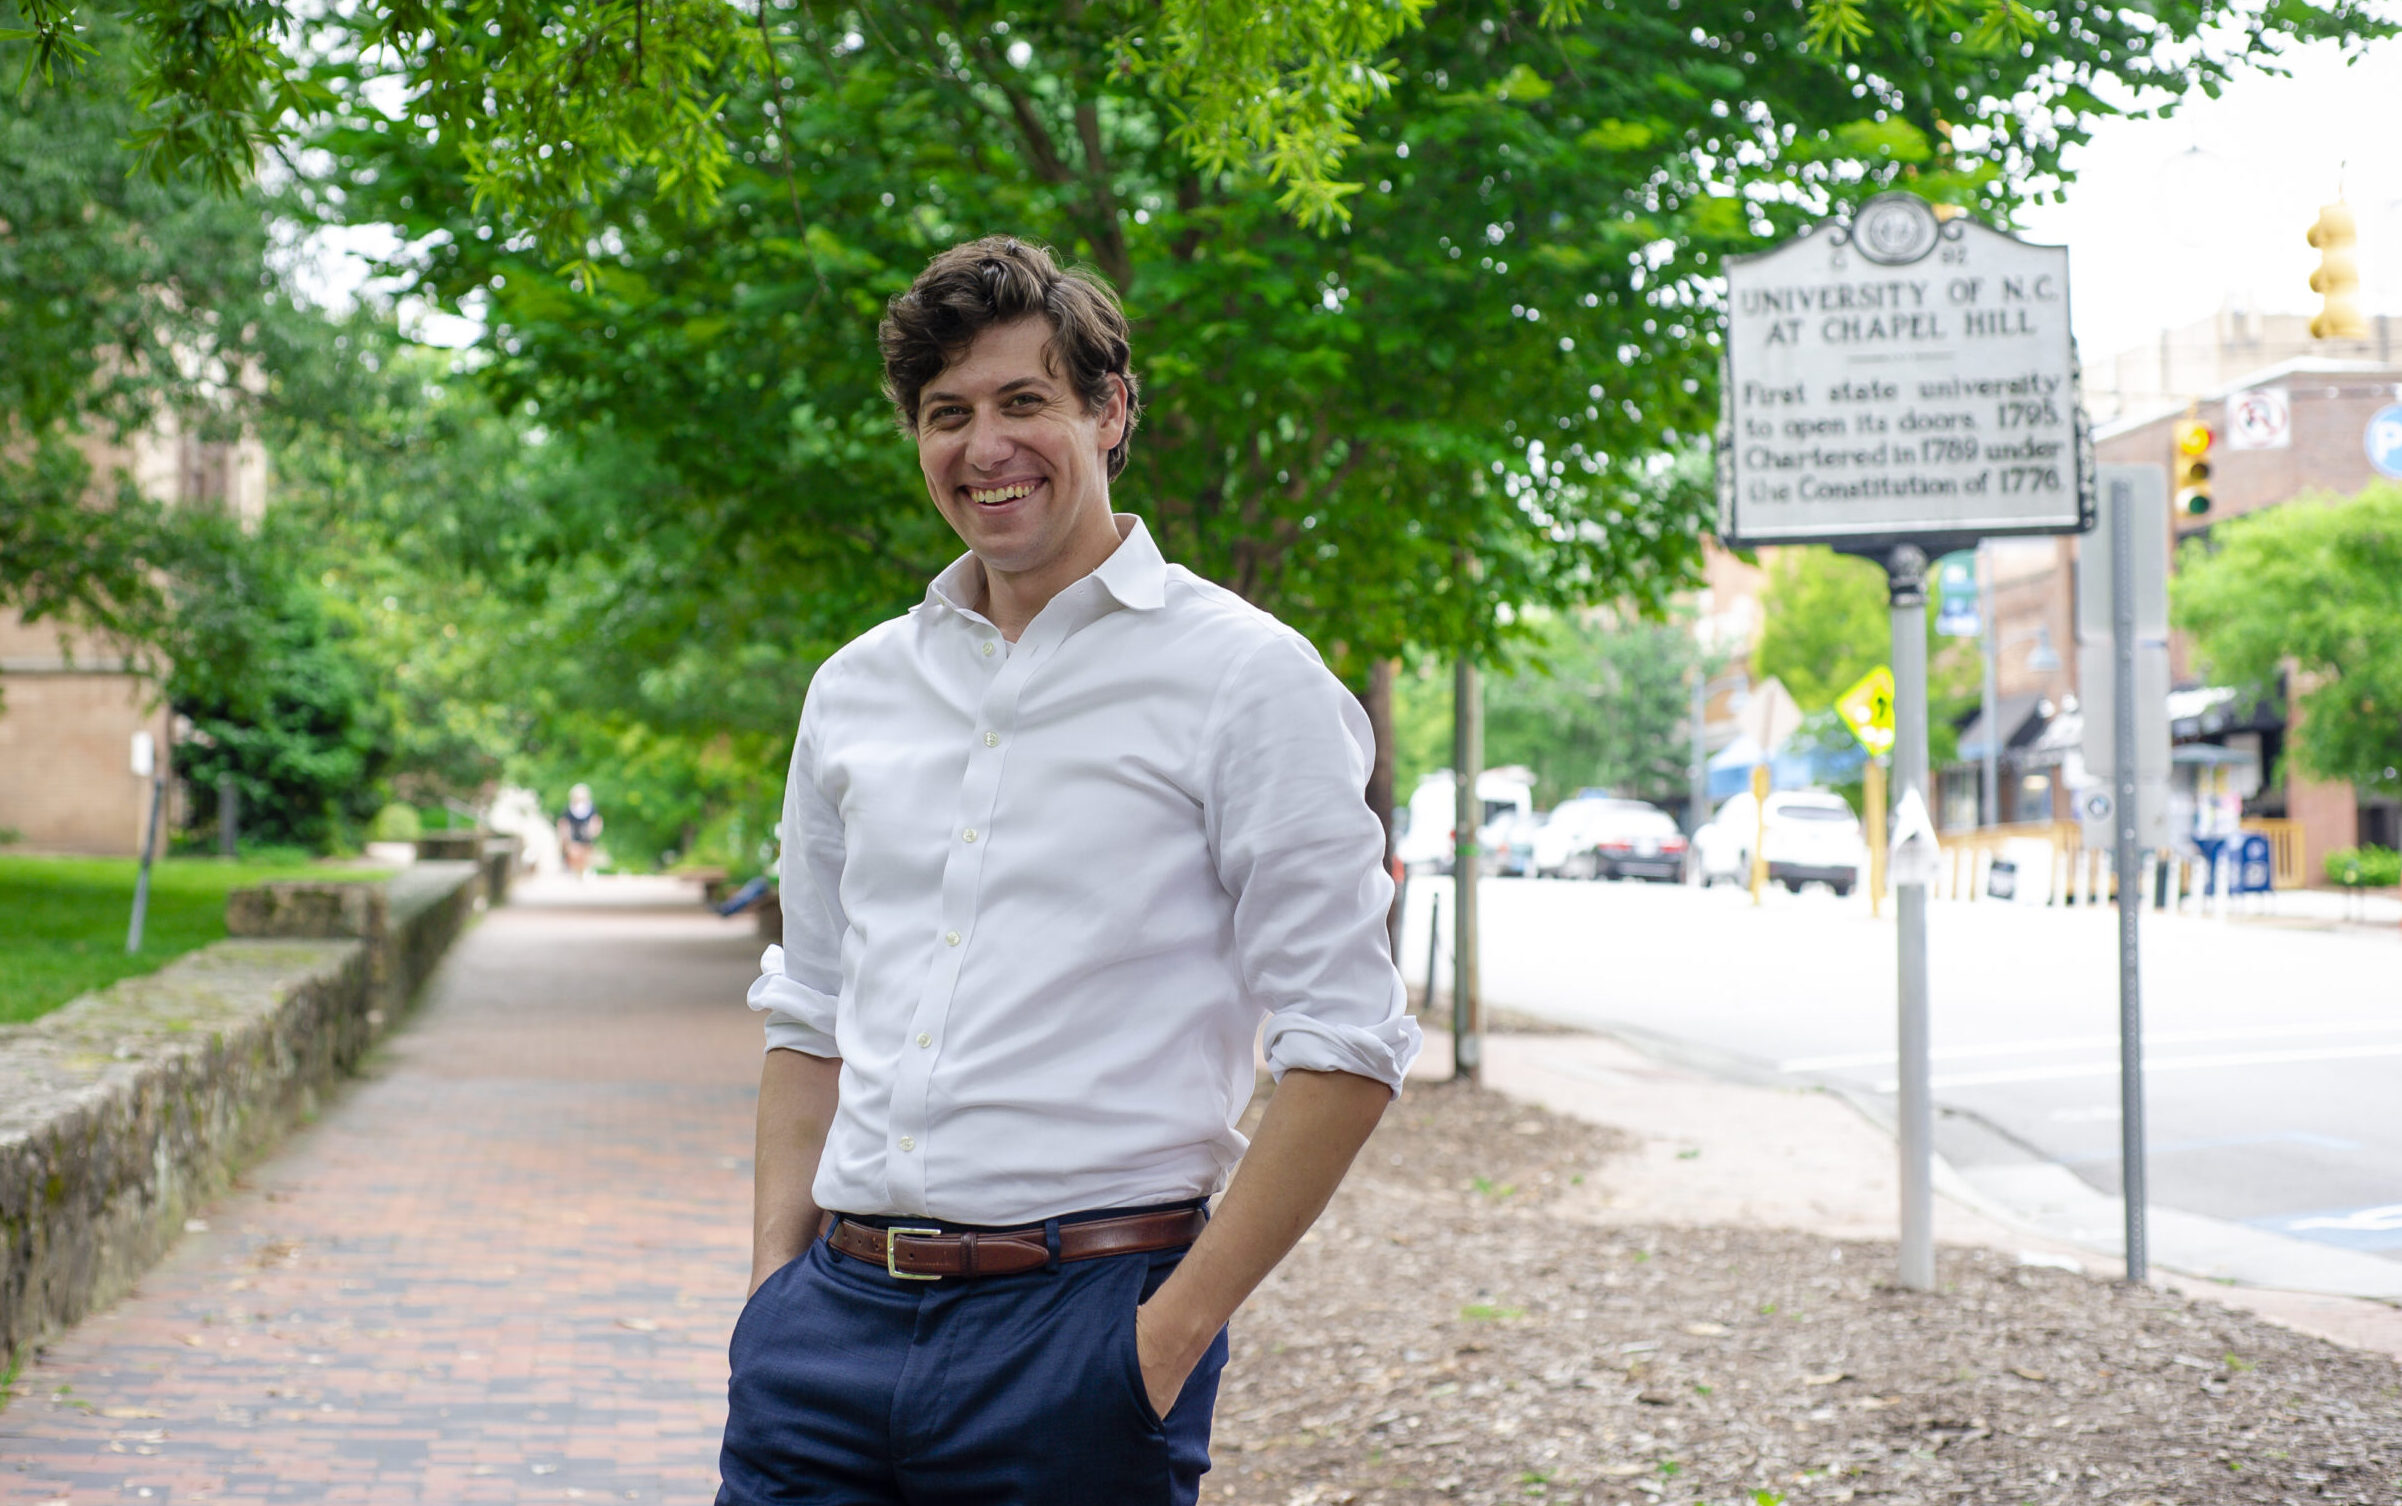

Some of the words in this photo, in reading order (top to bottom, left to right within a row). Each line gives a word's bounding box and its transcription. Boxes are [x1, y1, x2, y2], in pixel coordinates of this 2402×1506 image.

[1740, 280, 1927, 316] UNIVERSITY
[1947, 277, 1984, 305] OF
[2003, 274, 2059, 302] N.C.
[1765, 317, 1804, 346] AT
[1822, 311, 1947, 344] CHAPEL
[1965, 309, 2037, 337] HILL
[1744, 380, 1805, 406] First
[1830, 379, 1898, 402] state
[1919, 372, 2060, 398] university
[1745, 418, 1773, 438] to
[1783, 417, 1846, 441] open
[1856, 413, 1888, 433] its
[1998, 398, 2063, 430] 1795.
[1745, 440, 1887, 470] Chartered
[1893, 444, 1916, 464] in
[1922, 435, 1978, 463] 1789
[1985, 434, 2064, 461] under
[1749, 477, 1790, 503] the
[1800, 474, 1957, 501] Constitution
[1964, 469, 1989, 495] of
[1999, 464, 2064, 494] 1776.
